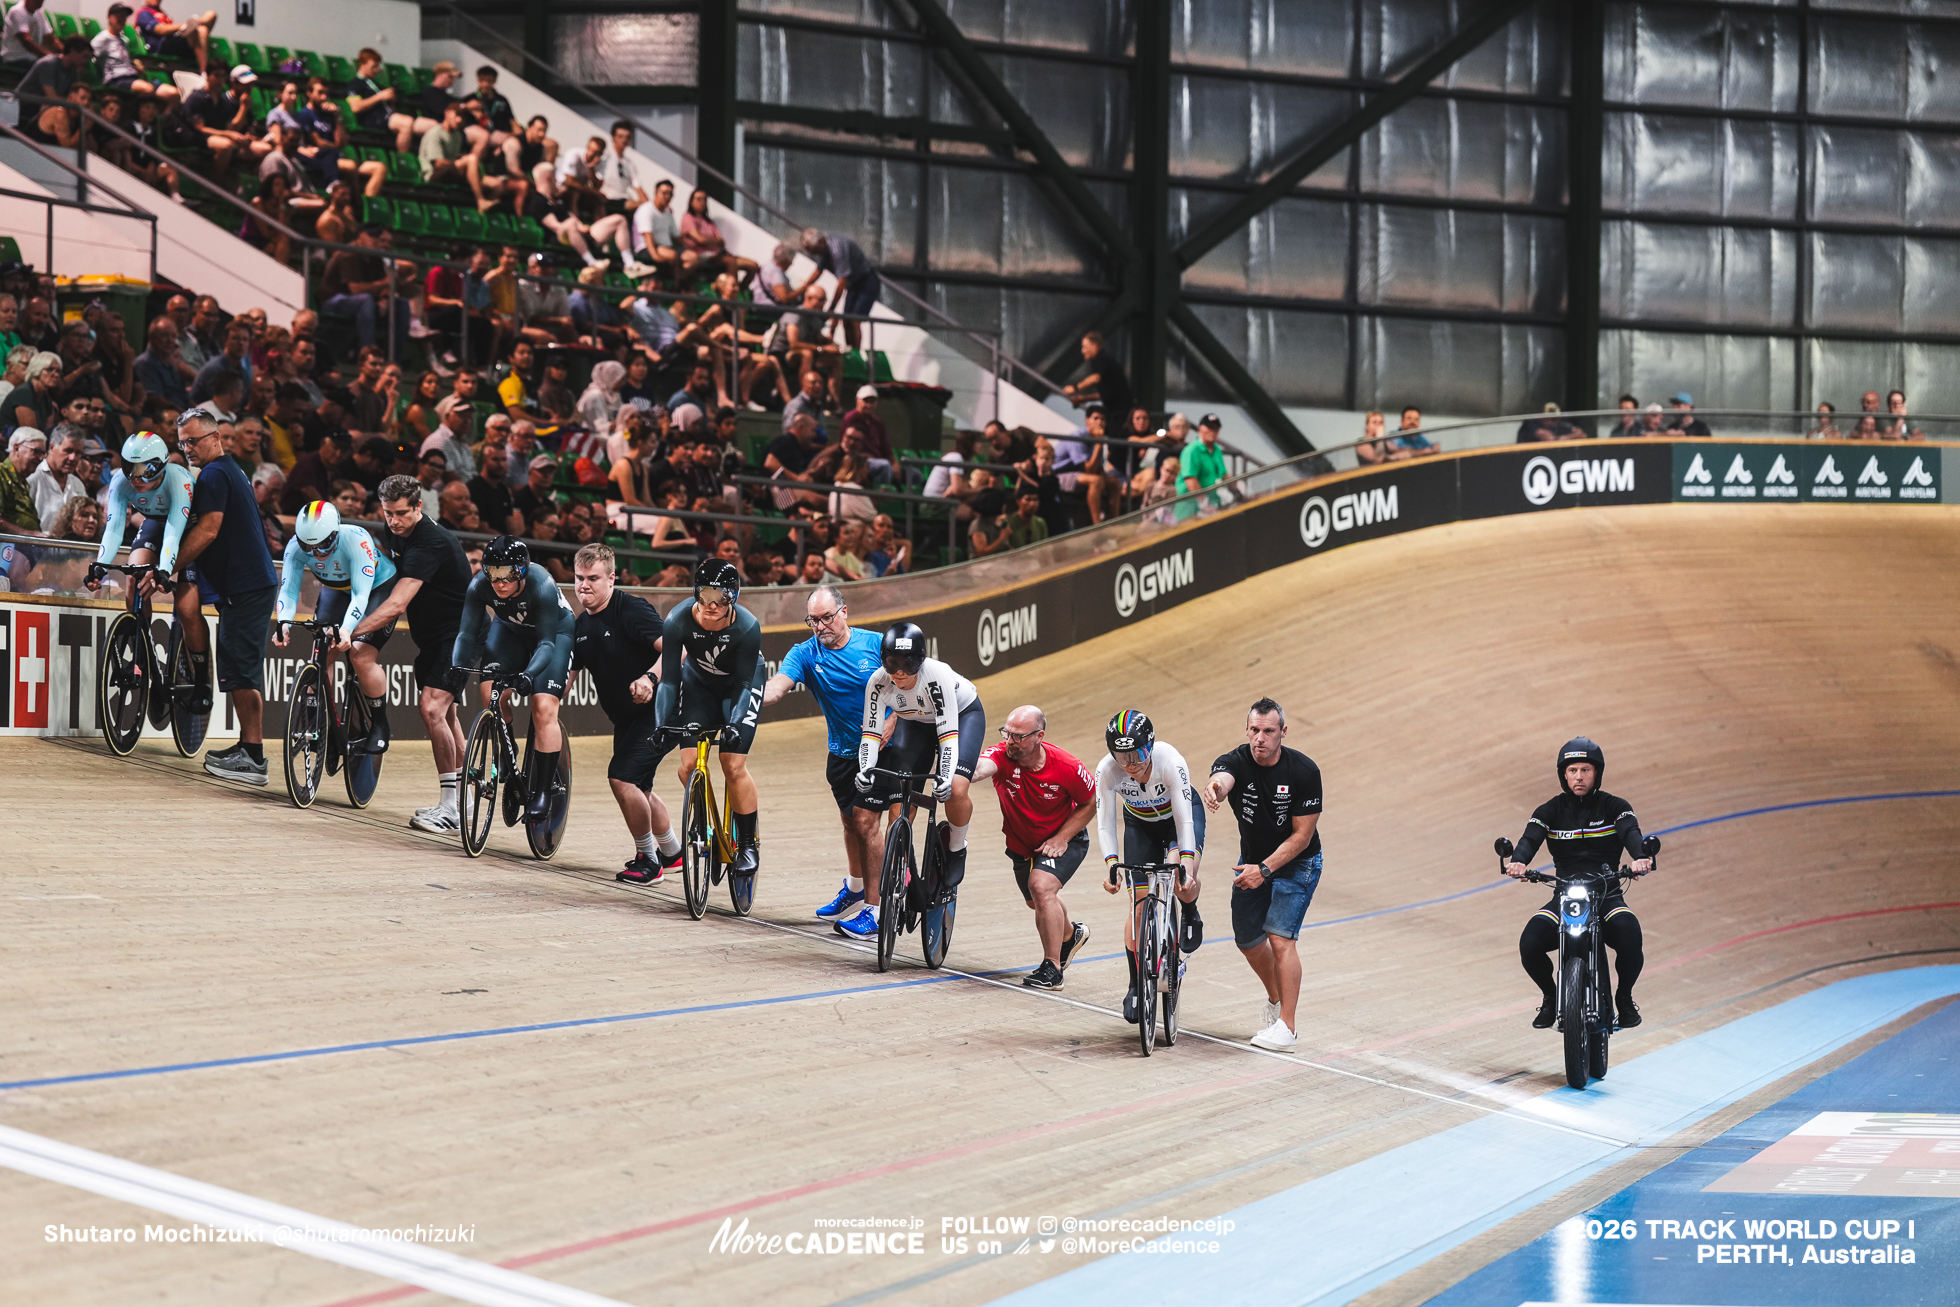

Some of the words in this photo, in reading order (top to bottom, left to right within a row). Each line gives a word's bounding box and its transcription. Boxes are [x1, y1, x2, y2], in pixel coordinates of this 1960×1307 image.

[1559, 458, 1635, 495] GWM
[1332, 485, 1399, 532] GWM
[1139, 548, 1194, 602] GWM
[351, 606, 362, 621] EY
[996, 603, 1037, 653] GWM
[741, 685, 764, 728] NZL
[956, 765, 972, 775] MANY
[1124, 788, 1140, 797] UCI
[1569, 902, 1581, 917] 3
